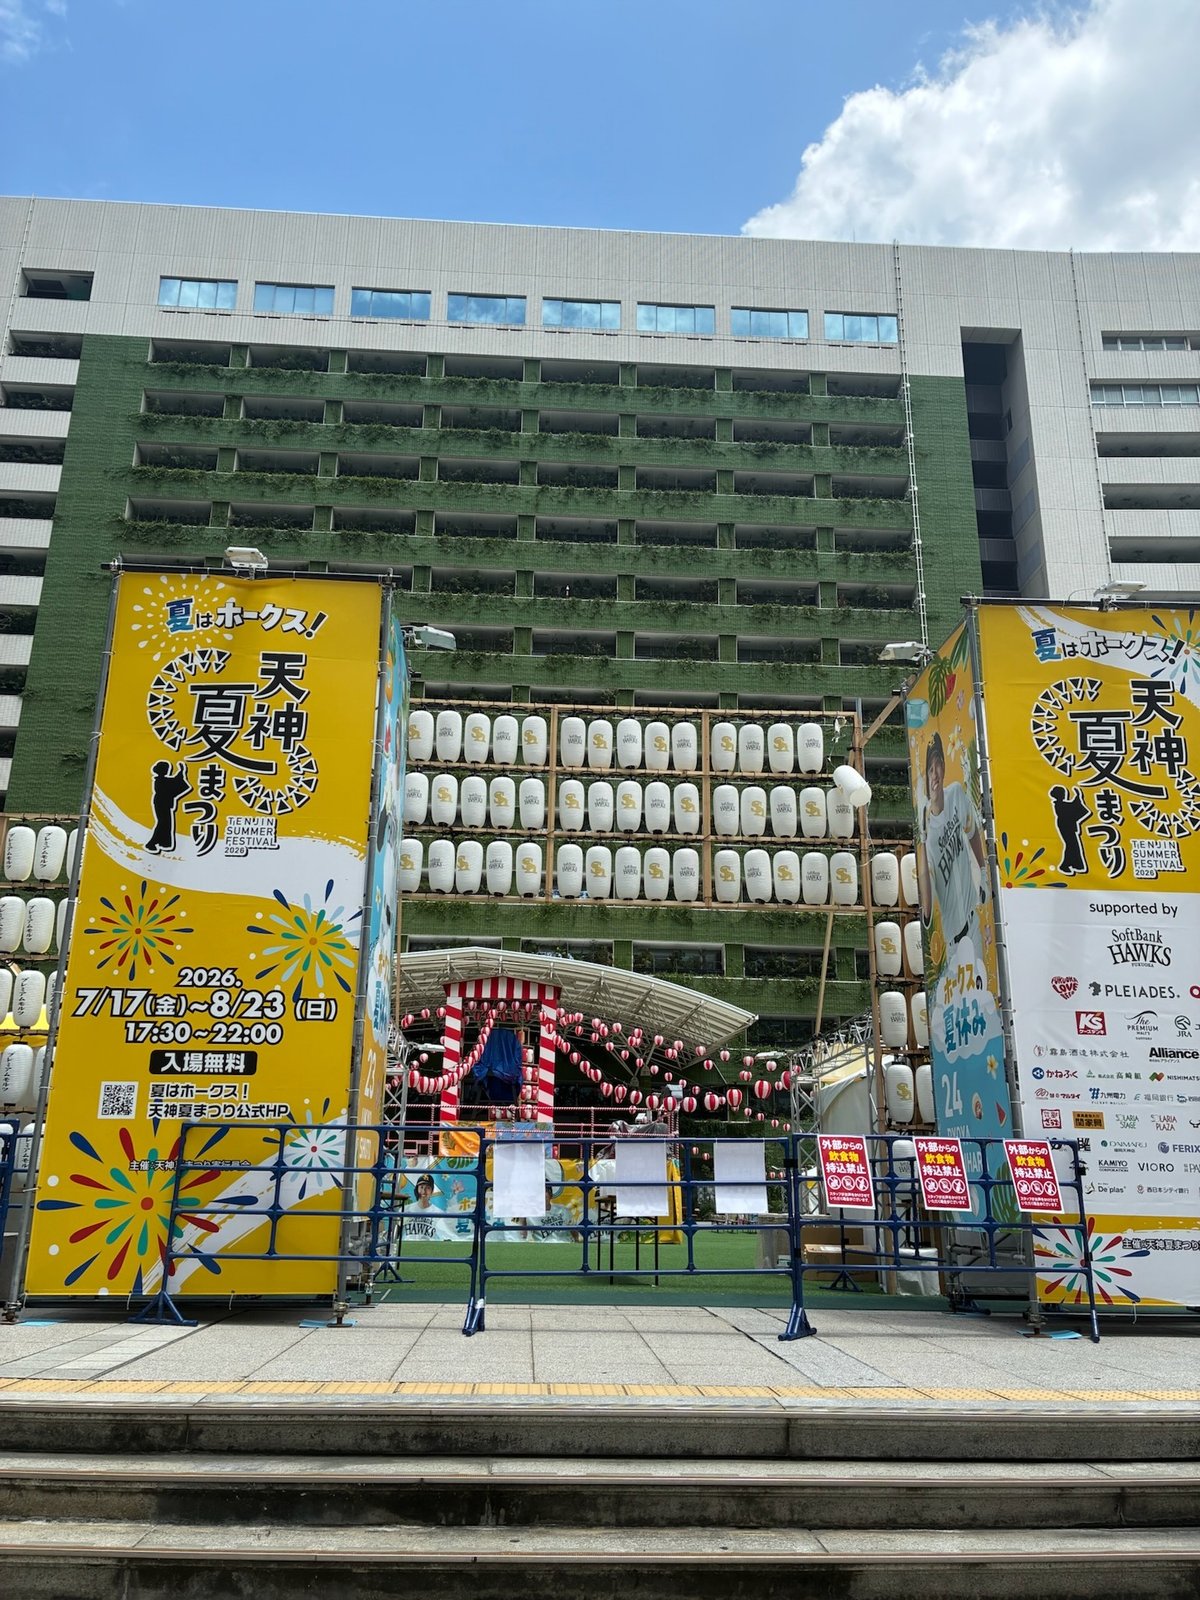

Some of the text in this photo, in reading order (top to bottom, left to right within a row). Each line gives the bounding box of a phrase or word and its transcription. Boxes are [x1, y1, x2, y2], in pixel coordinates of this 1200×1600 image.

[166, 597, 328, 640] 夏はホークス!
[1031, 628, 1186, 665] 夏はホークス!
[228, 817, 275, 827] TENJIN
[227, 827, 274, 837] SUMMER
[225, 836, 278, 848] FESTIVAL
[1131, 840, 1177, 850] TENJIN
[224, 846, 245, 855] 2026
[1132, 849, 1178, 859] SUMMER
[1133, 859, 1184, 869] FESTIVAL
[1135, 868, 1155, 877] 2026
[1089, 902, 1178, 918] supported by
[1111, 927, 1163, 944] SoftBank
[1106, 942, 1172, 967] HAWKS
[175, 967, 243, 988] 2026.
[1052, 983, 1079, 994] LOVE
[943, 997, 986, 1054] 夏休み
[1176, 1030, 1192, 1038] JRA
[1049, 1048, 1130, 1058] 霧島酒造株式会社
[1149, 1047, 1200, 1059] Alliance
[160, 1053, 246, 1073] 入場無料
[1046, 1069, 1079, 1079] かねふく
[150, 1083, 249, 1099] 夏はホークス！
[942, 1072, 962, 1118] 24
[1100, 1092, 1127, 1100] 九州電力
[1144, 1093, 1174, 1102] 福岡銀行
[148, 1104, 289, 1119] 天神夏まつり公式HP
[1156, 1123, 1176, 1131] PLAZA
[822, 1139, 864, 1150] 外部からの
[917, 1141, 958, 1152] 外部からの
[1008, 1144, 1048, 1155] 外部からの
[828, 1150, 859, 1163] 飲食物
[925, 1153, 955, 1165] 飲食物
[1015, 1155, 1046, 1168] 飲食物
[825, 1162, 867, 1174] 持込禁止
[922, 1164, 963, 1177] 持込禁止
[1013, 1167, 1054, 1179] 持込禁止
[1137, 1163, 1175, 1172] VIORO
[1146, 1187, 1190, 1195] 西日本シティ銀行
[404, 1223, 436, 1238] HAWKS
